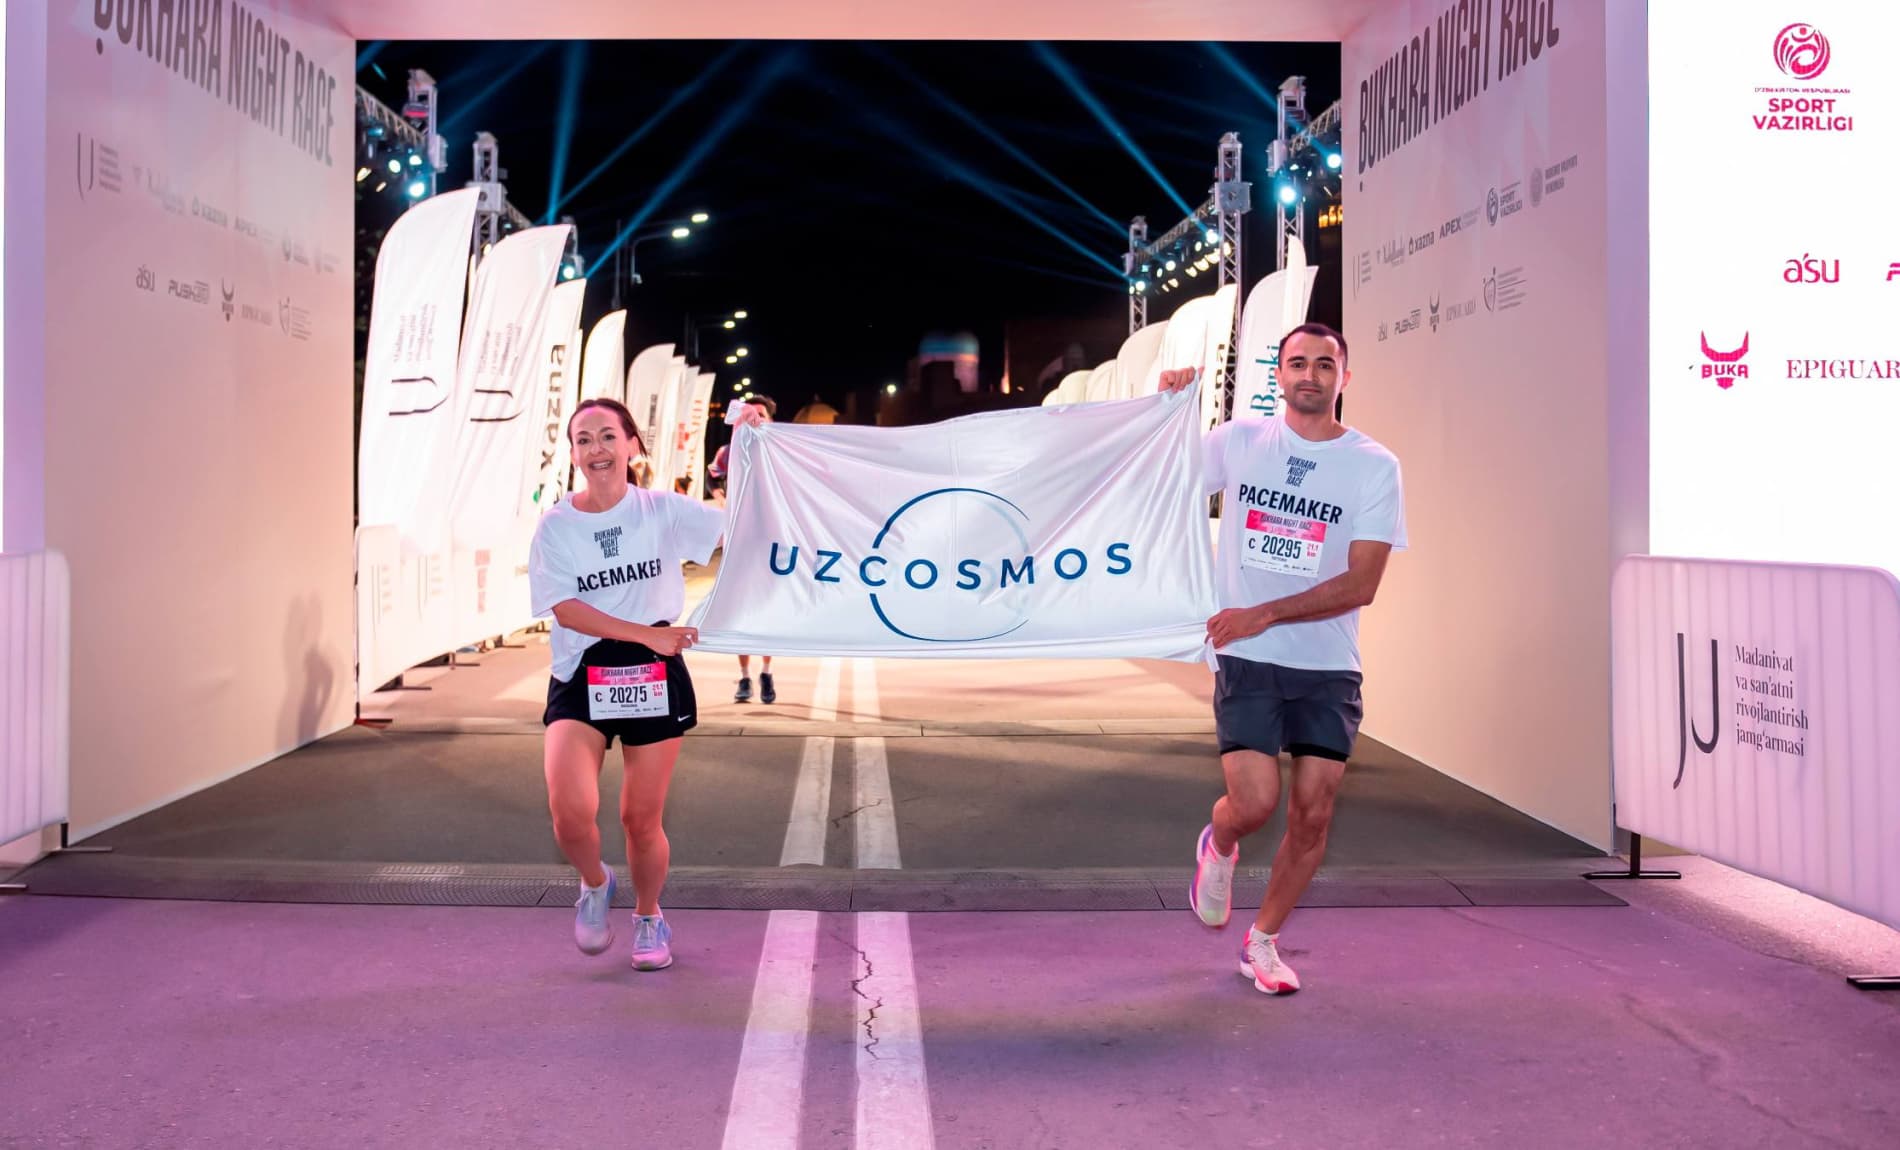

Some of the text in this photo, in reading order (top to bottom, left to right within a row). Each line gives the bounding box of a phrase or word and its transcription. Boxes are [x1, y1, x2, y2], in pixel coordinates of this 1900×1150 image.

[94, 0, 336, 167] HARA NIGHT RACE
[1359, 26, 1431, 176] BUKHARA
[1768, 98, 1836, 113] SPORT
[1752, 115, 1853, 131] VAZIRLIGI
[1439, 217, 1462, 239] APEX
[1701, 364, 1749, 379] BUKA
[1286, 455, 1317, 470] BUKHARA
[1288, 466, 1308, 478] NIGHT
[1285, 475, 1303, 487] RACE
[1238, 483, 1343, 525] PACEMAKER
[1283, 518, 1299, 528] NIGHT
[593, 526, 623, 542] BUKHARA
[600, 537, 618, 550] NIGHT
[1248, 538, 1256, 549] C
[1261, 534, 1302, 559] 20295
[1307, 543, 1319, 551] 21.1
[603, 546, 619, 559] RACE
[768, 541, 1132, 590] UZCOSMOS
[1735, 645, 1793, 672] Madaniyat
[624, 667, 639, 677] NIGHT
[595, 683, 664, 703] C 20275 21.1
[1736, 675, 1793, 700] va san'atni
[1736, 698, 1808, 730] rivojlantirish
